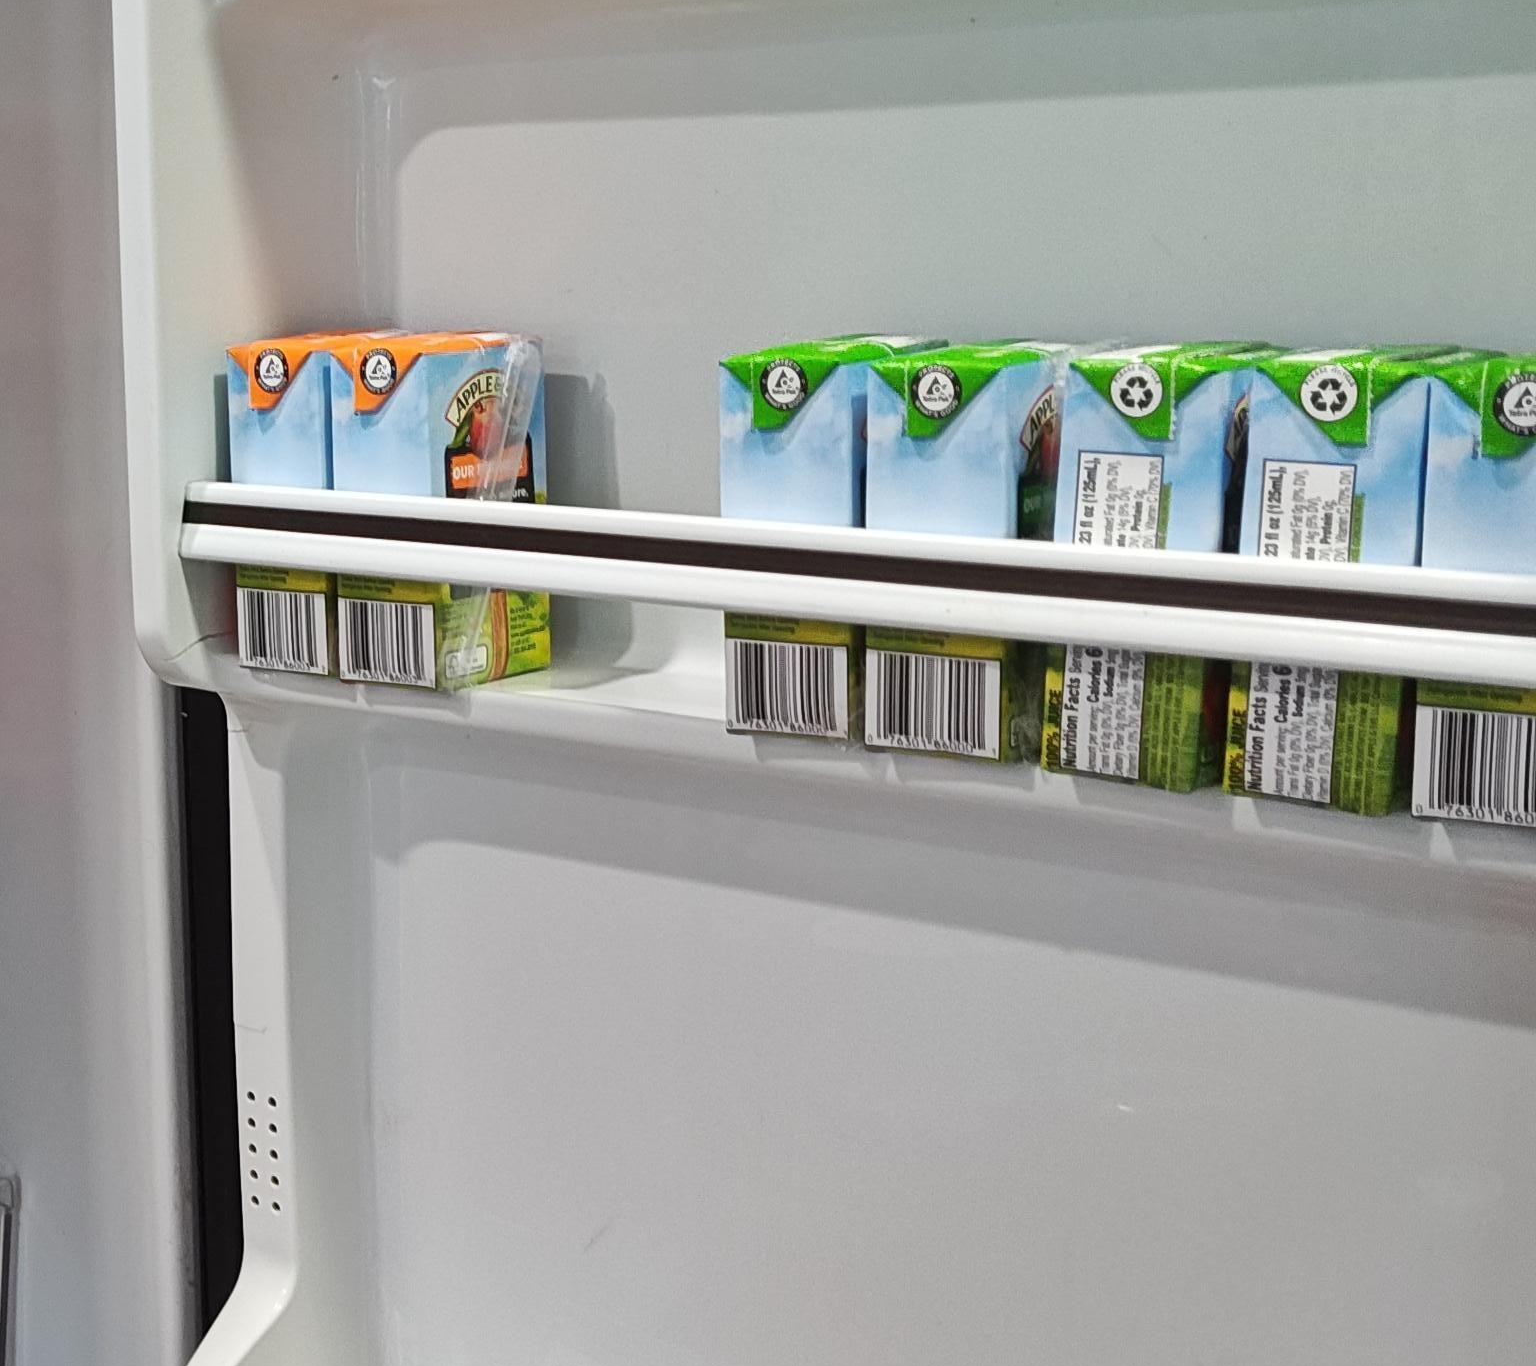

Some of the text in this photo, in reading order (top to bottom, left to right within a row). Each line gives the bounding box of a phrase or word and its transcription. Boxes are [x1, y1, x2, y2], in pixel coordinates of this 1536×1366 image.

[453, 465, 474, 479] OUR
[1087, 660, 1102, 703] Calories
[1275, 679, 1291, 723] Calories
[1063, 678, 1080, 767] Nutrition Facts
[1248, 697, 1267, 790] Nutrition Facts
